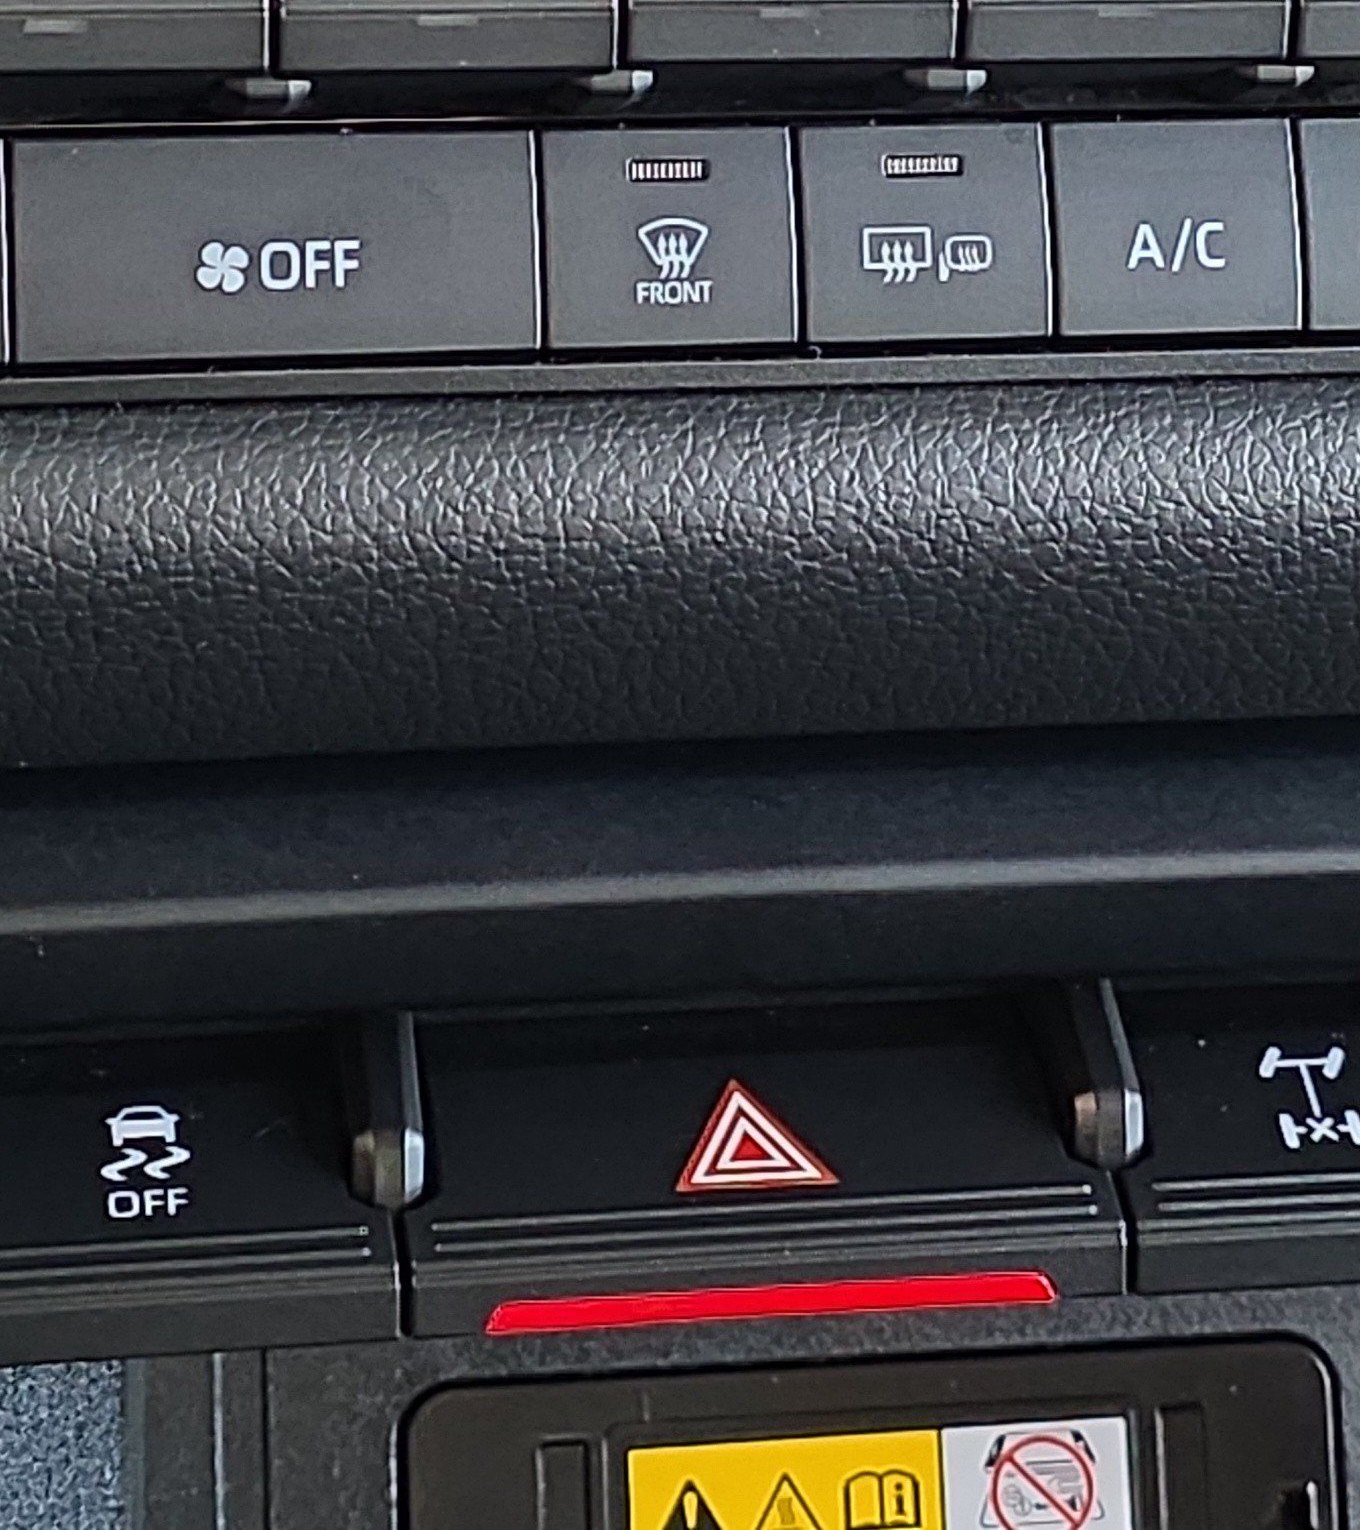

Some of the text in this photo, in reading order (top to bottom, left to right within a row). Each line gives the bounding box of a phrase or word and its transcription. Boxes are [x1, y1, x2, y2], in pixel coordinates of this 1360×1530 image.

[260, 240, 361, 290] OFF
[1127, 218, 1227, 272] A/C
[636, 281, 714, 305] FRONT
[105, 1185, 189, 1220] OFF
